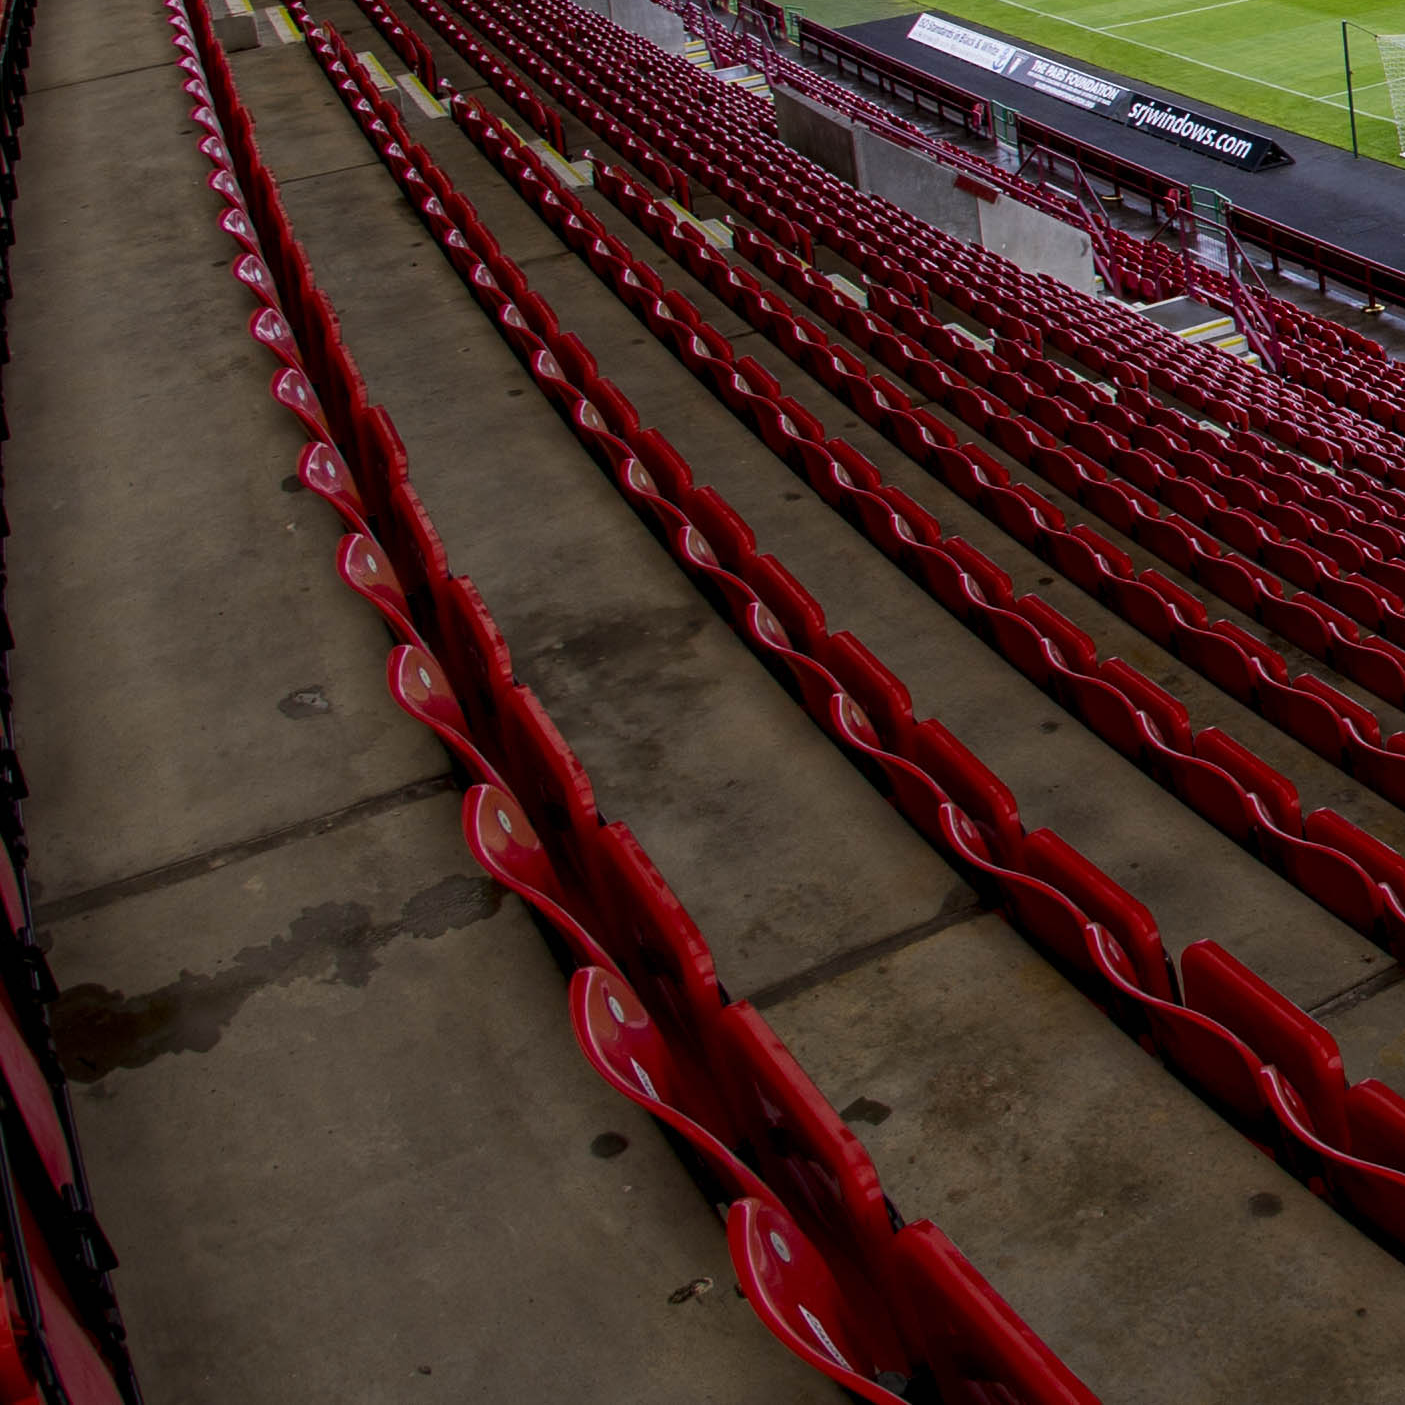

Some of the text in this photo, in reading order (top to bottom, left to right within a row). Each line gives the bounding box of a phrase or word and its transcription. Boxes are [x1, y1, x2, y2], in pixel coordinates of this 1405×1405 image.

[1031, 59, 1050, 74] THE
[1065, 72, 1121, 101] FOUNDATION
[1128, 101, 1253, 159] srjwindows.com
